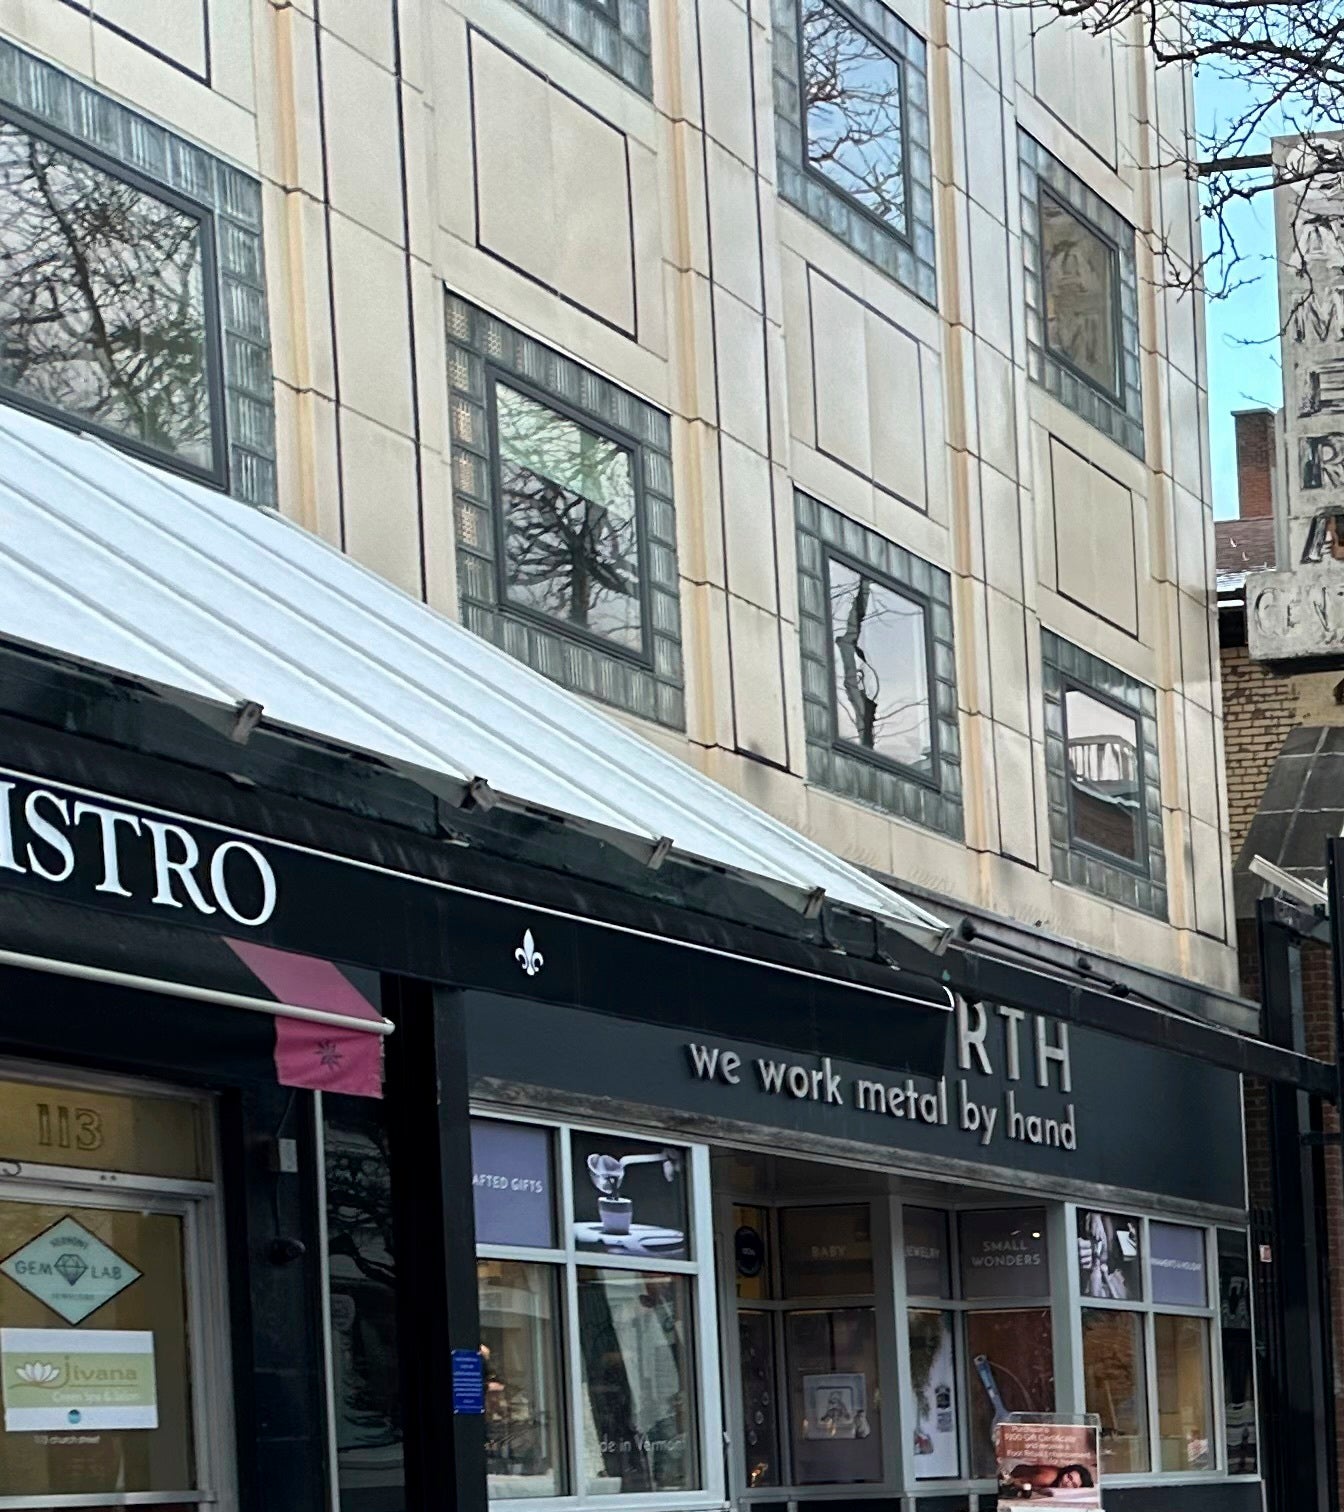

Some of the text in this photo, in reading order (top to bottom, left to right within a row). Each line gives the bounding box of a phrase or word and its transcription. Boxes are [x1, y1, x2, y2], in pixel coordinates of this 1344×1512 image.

[689, 1043, 1077, 1151] we work metal by hand
[36, 1103, 103, 1151] 113
[472, 1173, 543, 1194] AFTED GIFTS
[811, 1245, 846, 1258] BABY
[983, 1240, 1027, 1252] SMALL
[15, 1261, 122, 1280] GEM LAB
[971, 1254, 1041, 1268] WONDERS
[62, 1356, 137, 1386] jivana
[619, 1433, 632, 1451] in
